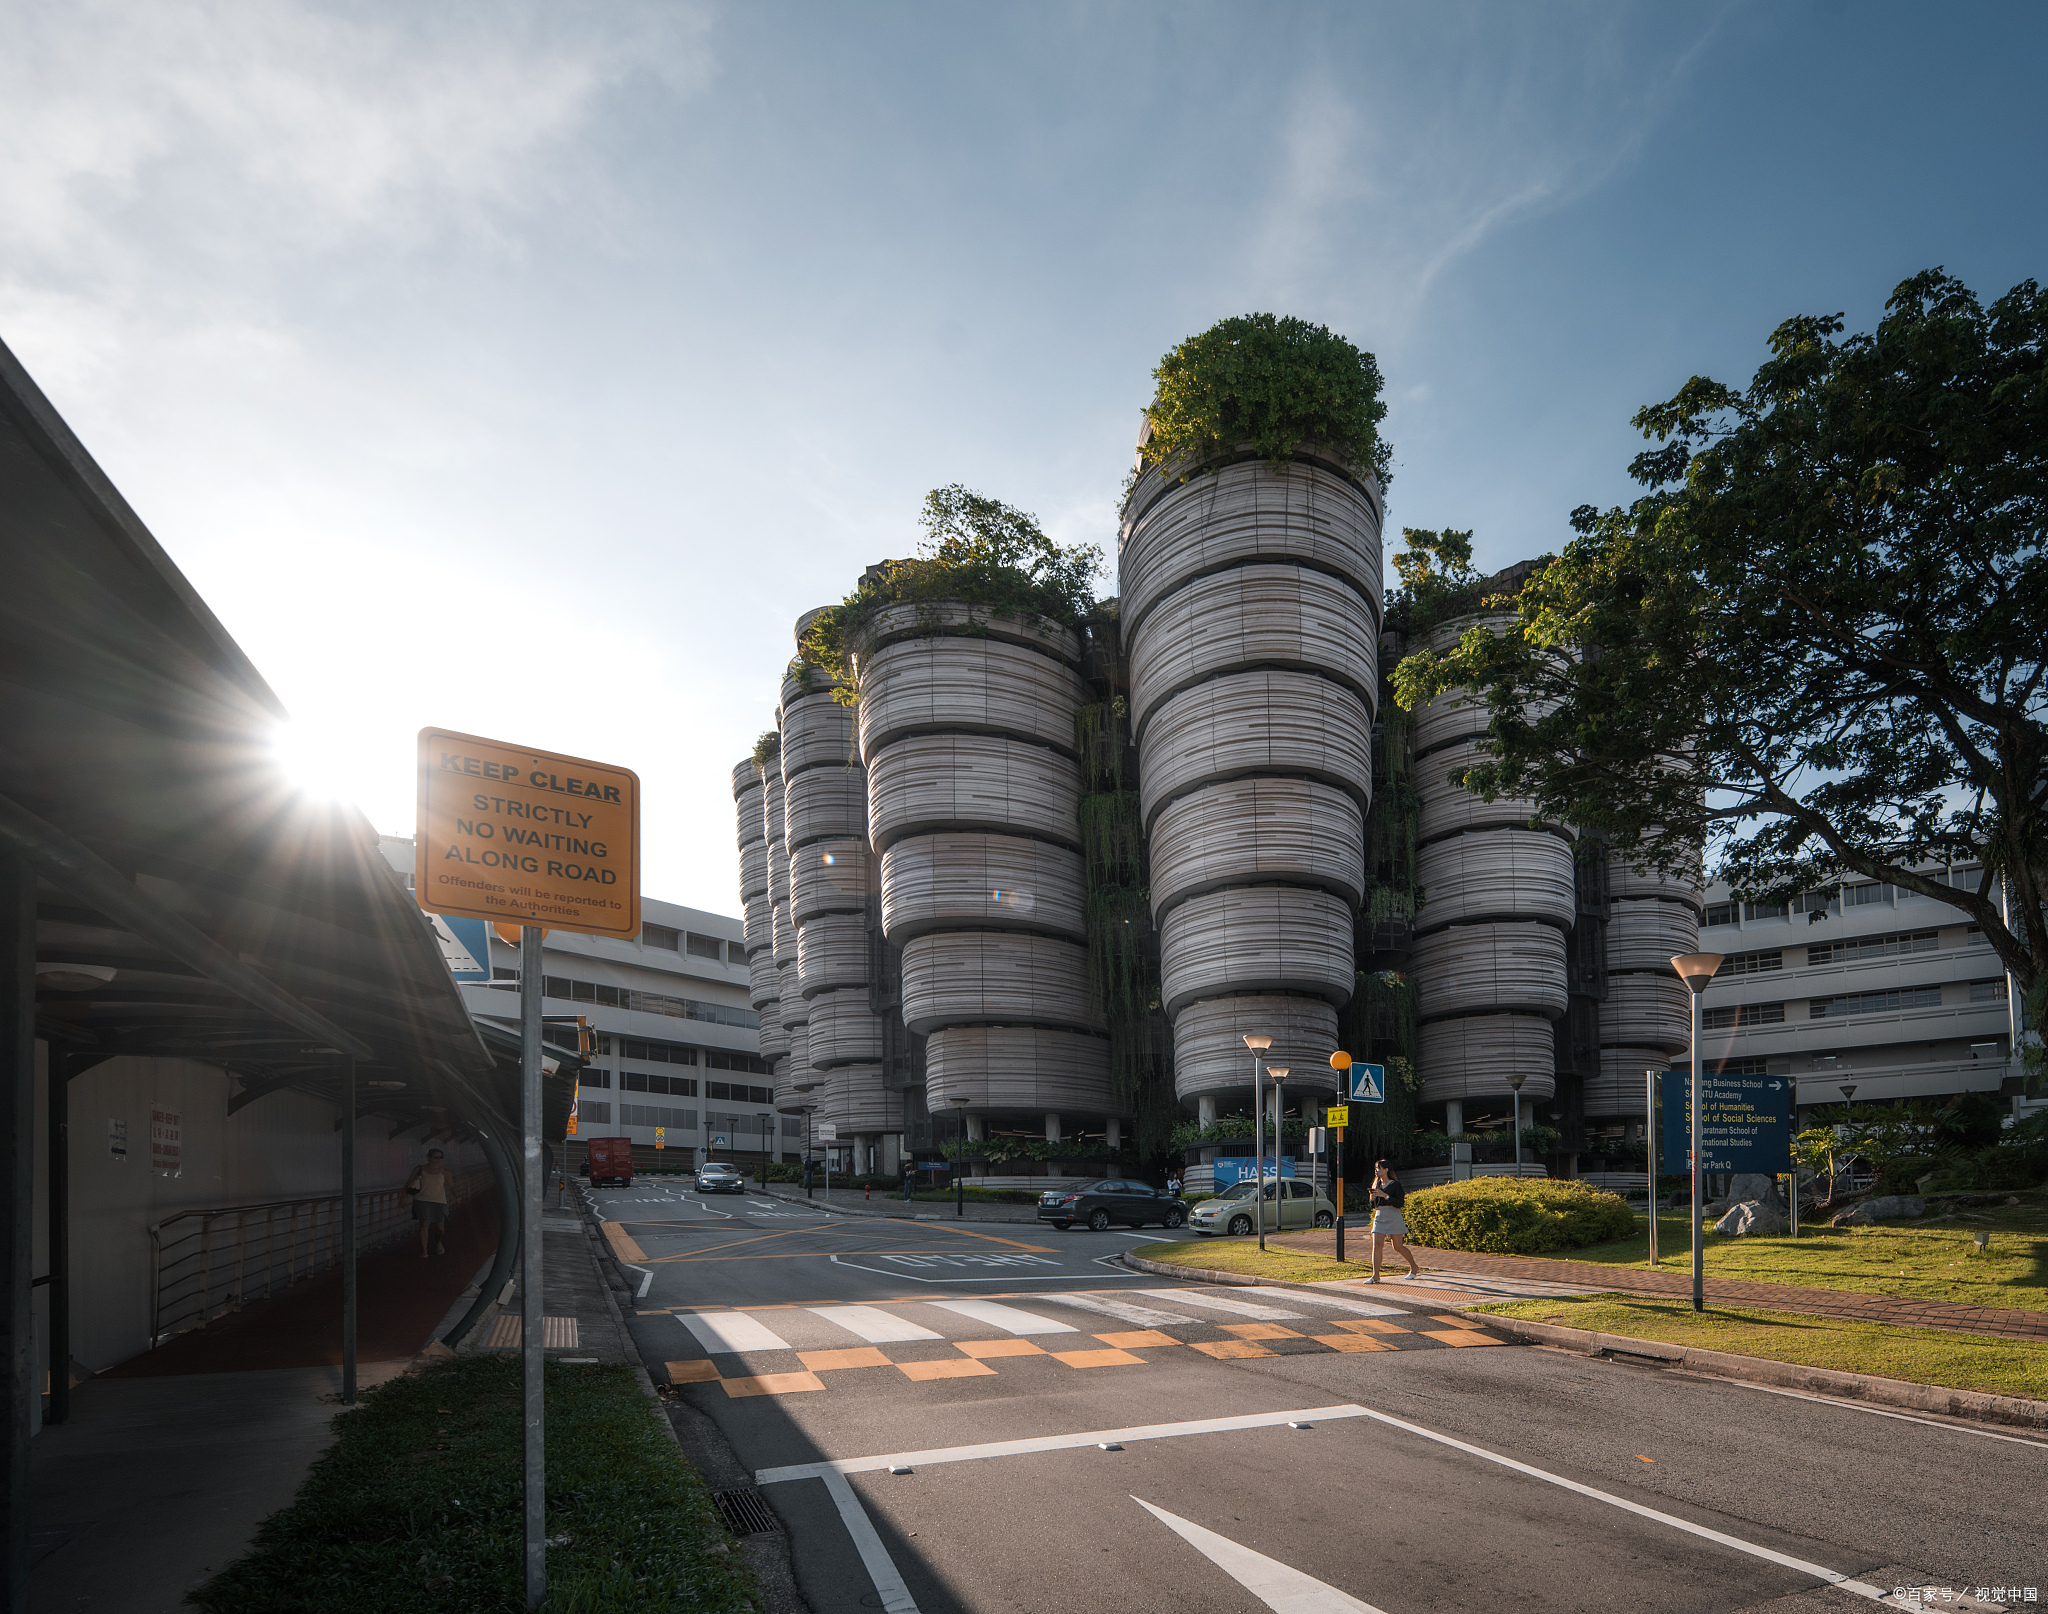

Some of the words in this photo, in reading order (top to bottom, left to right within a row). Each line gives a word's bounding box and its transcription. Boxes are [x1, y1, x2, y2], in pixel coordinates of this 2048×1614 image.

[440, 752, 519, 781] KEEP
[530, 771, 622, 804] CLEAR
[473, 794, 594, 830] STRICTLY
[457, 818, 495, 839] NO
[502, 826, 608, 858] WAITING
[445, 845, 539, 873] ALONG
[547, 860, 617, 885] ROAD
[438, 874, 505, 893] Offenders
[509, 885, 531, 897] will
[535, 888, 551, 900] be
[554, 893, 607, 908] reported
[610, 899, 622, 910] to
[486, 895, 506, 907] the
[509, 897, 580, 917] Authorities
[1713, 1078, 1741, 1088] Business
[1742, 1080, 1763, 1089] School
[1714, 1091, 1742, 1101] Academy
[1710, 1102, 1717, 1111] of
[1719, 1102, 1755, 1111] Humanities
[1712, 1113, 1720, 1122] of
[1722, 1113, 1744, 1123] Social
[1746, 1113, 1777, 1123] Sciences
[1729, 1126, 1750, 1135] School
[1751, 1126, 1758, 1135] of
[1729, 1138, 1752, 1147] Studies
[1710, 1161, 1725, 1169] Park
[1725, 1161, 1732, 1170] Q
[1238, 1166, 1277, 1179] HASS
